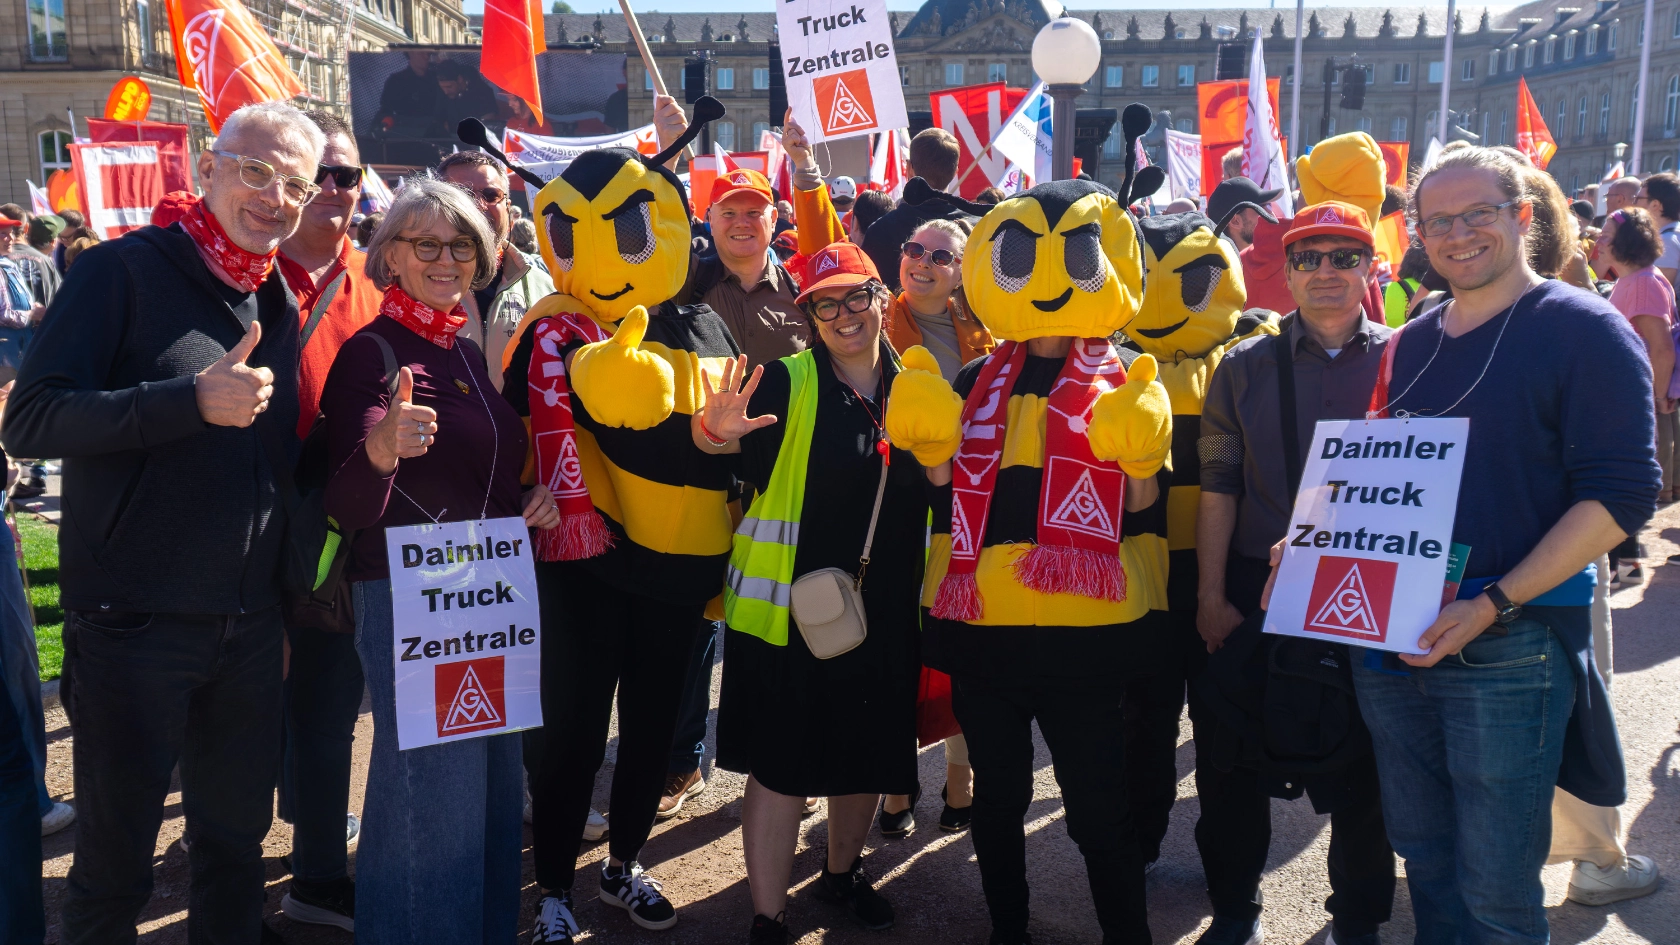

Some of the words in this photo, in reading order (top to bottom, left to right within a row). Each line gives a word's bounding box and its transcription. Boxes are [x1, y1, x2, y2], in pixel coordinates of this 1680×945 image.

[797, 5, 867, 36] Truck
[787, 41, 890, 77] Zentrale
[113, 81, 139, 121] MLPD
[1321, 435, 1456, 460] Daimler
[1326, 480, 1426, 507] Truck
[401, 536, 523, 568] Daimler
[1290, 524, 1443, 559] Zentrale
[421, 581, 515, 612] Truck
[400, 624, 536, 662] Zentrale
